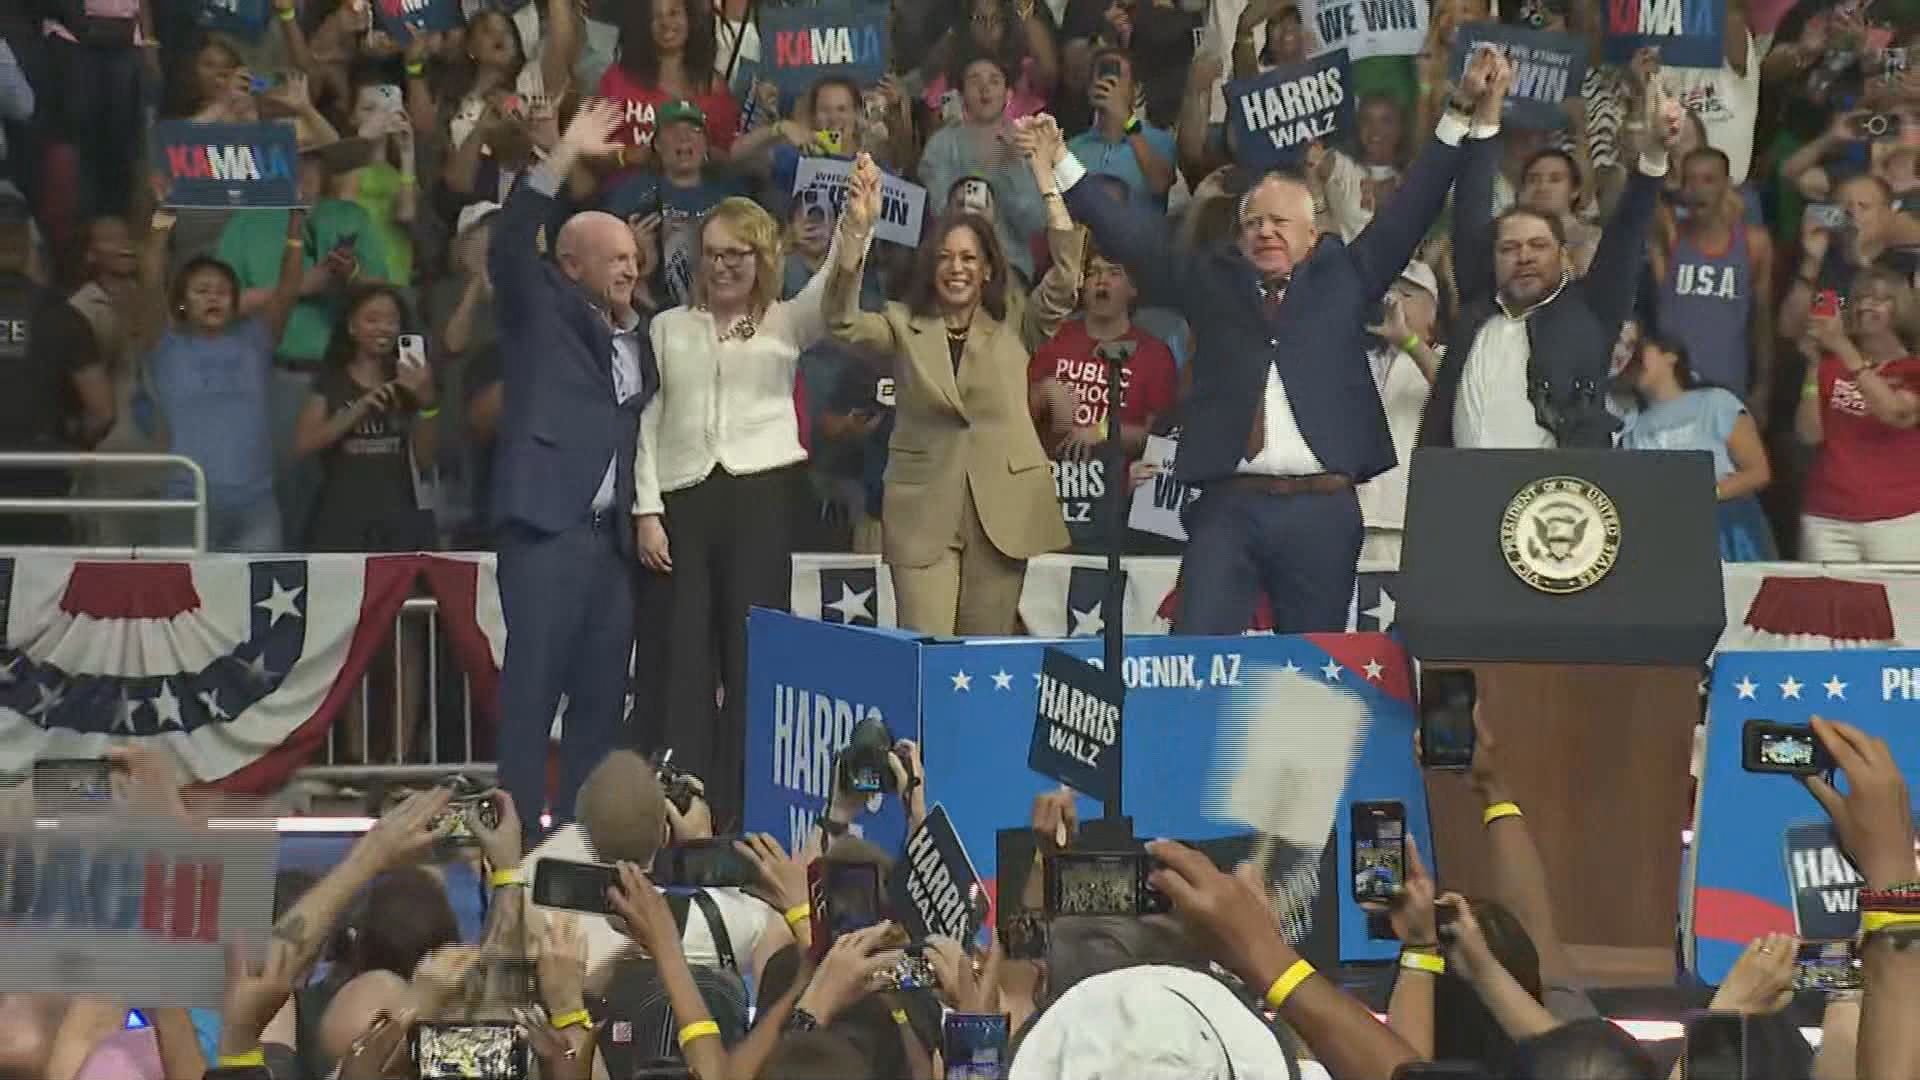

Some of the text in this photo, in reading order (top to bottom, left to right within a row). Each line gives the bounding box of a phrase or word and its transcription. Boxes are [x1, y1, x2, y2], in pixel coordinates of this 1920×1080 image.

[1361, 0, 1418, 32] WIN
[775, 27, 880, 66] KAMALA
[1240, 66, 1344, 133] HARRIS
[1268, 111, 1338, 149] WALZ
[164, 144, 290, 180] KAMALA
[1055, 358, 1133, 388] PUBLC
[1087, 653, 1242, 691] OENIX, AZ
[1039, 672, 1120, 746] HARRIS
[1048, 722, 1100, 770] WALZ
